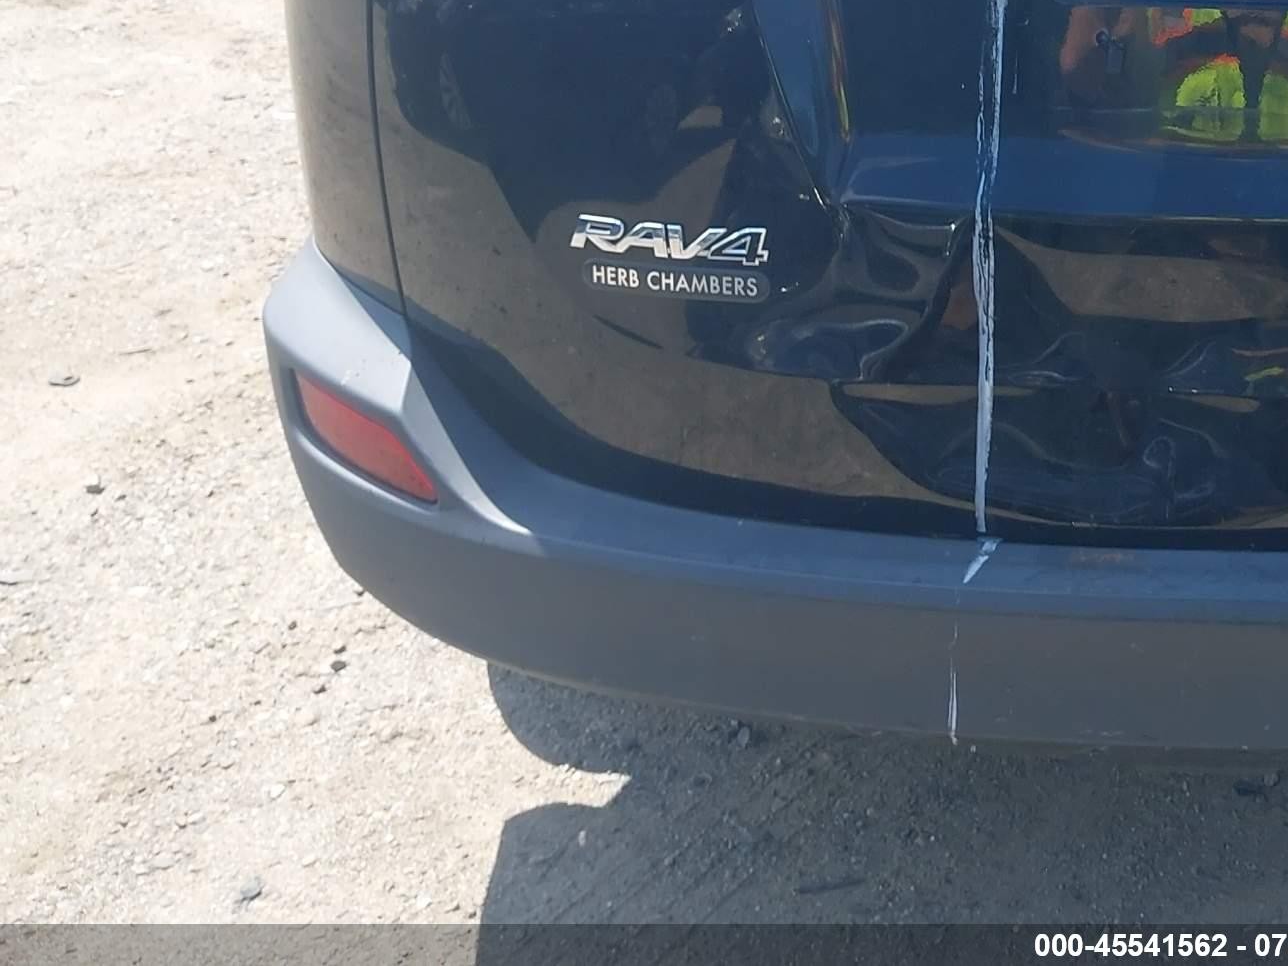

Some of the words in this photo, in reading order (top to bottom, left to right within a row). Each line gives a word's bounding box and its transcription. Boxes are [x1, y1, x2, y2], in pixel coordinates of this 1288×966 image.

[570, 213, 769, 266] RAV4
[592, 264, 640, 288] HERB
[646, 270, 758, 297] CHAMBERS
